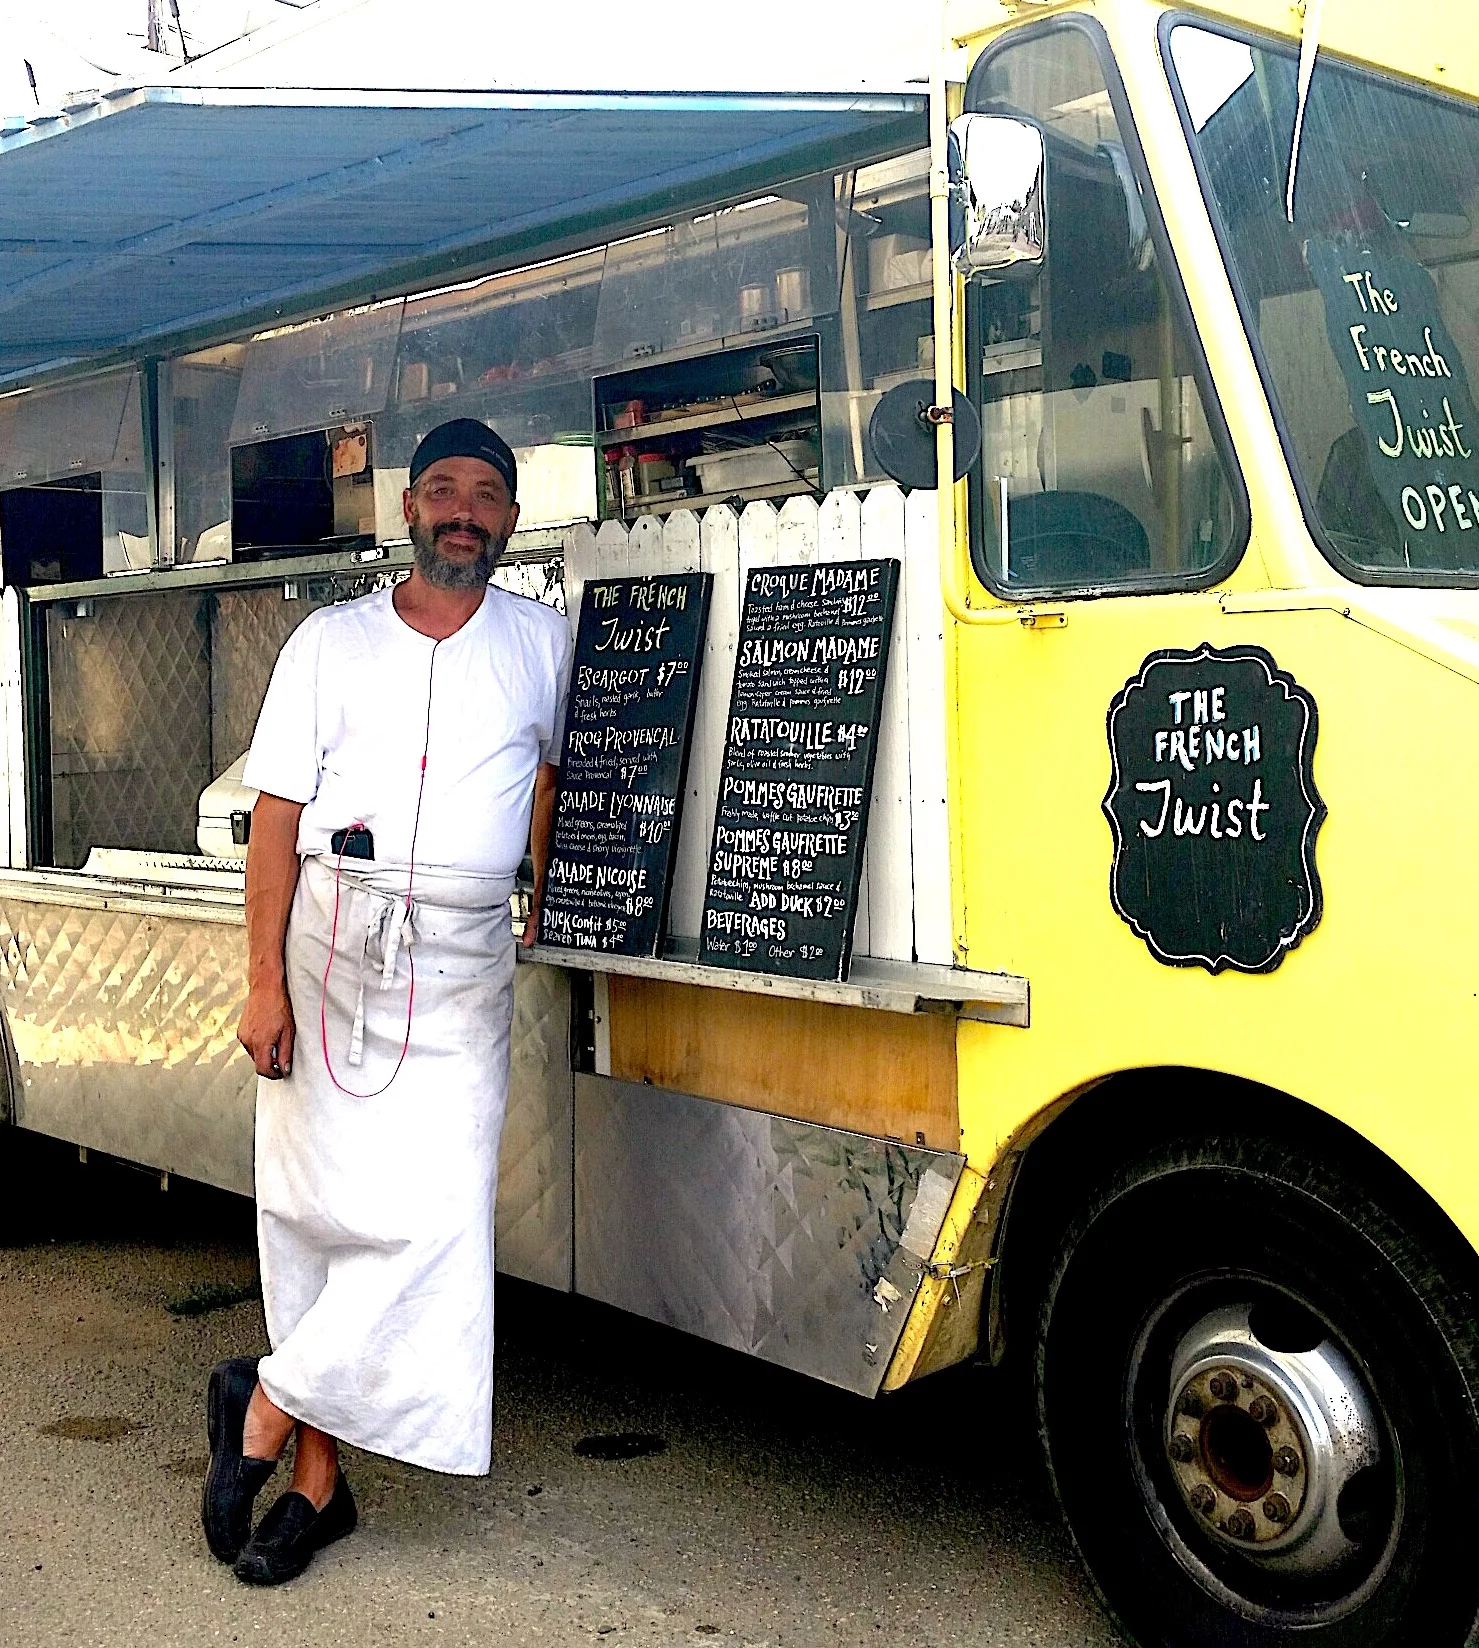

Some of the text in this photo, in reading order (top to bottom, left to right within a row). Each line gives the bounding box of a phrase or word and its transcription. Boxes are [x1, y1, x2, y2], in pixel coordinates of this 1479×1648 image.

[1342, 271, 1398, 316] The
[1349, 324, 1451, 378] French
[1366, 389, 1472, 459] Twist
[593, 582, 687, 612] THE FRENCH
[751, 568, 880, 598] CROQUE MADAME
[748, 603, 773, 614] Toasted
[776, 601, 790, 610] ham
[595, 617, 669, 651] Twist
[740, 636, 880, 667] SALMON MADAME
[577, 665, 649, 692] ESCARGOT
[738, 669, 760, 678] Smoked
[580, 709, 597, 723] fresh
[600, 708, 617, 718] herbs
[1168, 687, 1226, 725] THE
[569, 730, 602, 756] FROG
[730, 717, 832, 750] RATATOUILLE
[1154, 724, 1261, 772] FRENCH
[642, 751, 658, 762] with
[728, 746, 746, 758] Blend
[746, 748, 756, 760] of
[762, 759, 771, 768] oil
[559, 791, 675, 818] SALADE LYONNAISE
[724, 776, 864, 814] POMMES GAUFRETTE
[1135, 778, 1270, 841] Twist
[720, 806, 740, 823] Freshly
[716, 826, 848, 858] POMMES GAUFRETTE
[549, 858, 646, 893] SALADE NICOISE
[714, 850, 778, 880] SUPREME
[753, 882, 784, 891] mushroom
[816, 882, 834, 890] sauce
[748, 891, 777, 910] ADD
[780, 892, 814, 918] DUCK
[706, 908, 786, 940] BEVERAGES
[574, 932, 597, 948] TUNA
[706, 936, 731, 952] Water
[768, 945, 796, 958] Other
